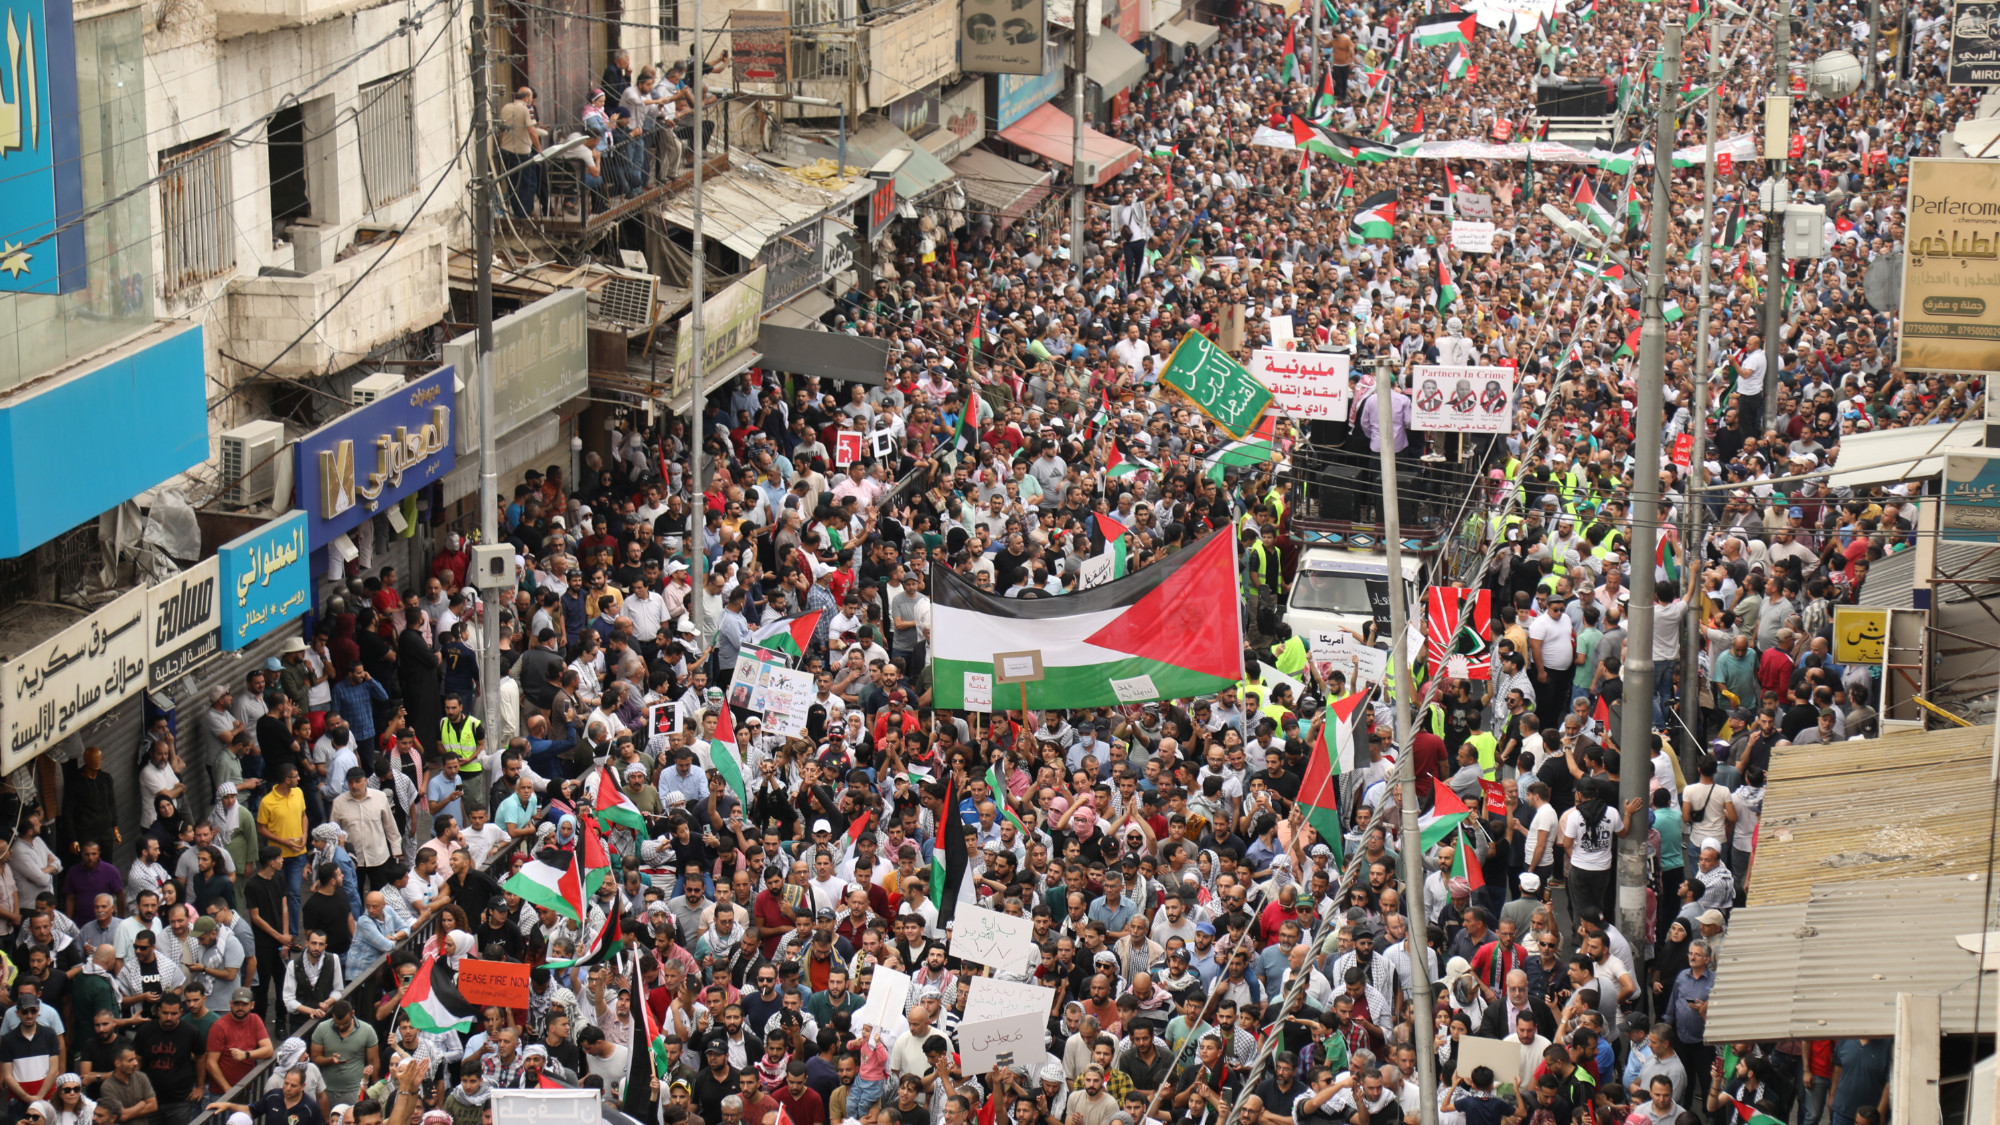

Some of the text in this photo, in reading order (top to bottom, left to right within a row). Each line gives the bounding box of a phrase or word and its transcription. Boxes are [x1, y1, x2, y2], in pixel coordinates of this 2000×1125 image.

[1958, 50, 1997, 61] العربي
[1959, 299, 1984, 311] جملة
[1264, 355, 1335, 381] مليونية
[1421, 368, 1506, 380] Partners In Crime
[1268, 382, 1342, 401] إسقاط إتفاق
[1268, 402, 1328, 416] وادي عرب
[1421, 421, 1456, 429] الجريمة
[1457, 423, 1471, 431] في
[236, 524, 304, 608] المعلواني
[279, 589, 305, 616] روسي
[238, 604, 268, 637] إيطالي
[1319, 633, 1344, 646] أمريكا
[17, 609, 142, 699] سوق سكرية
[448, 653, 459, 671] 7
[11, 655, 144, 752] محلات مسامح للألبسة
[460, 972, 530, 988] CEASE FIRE NOW
